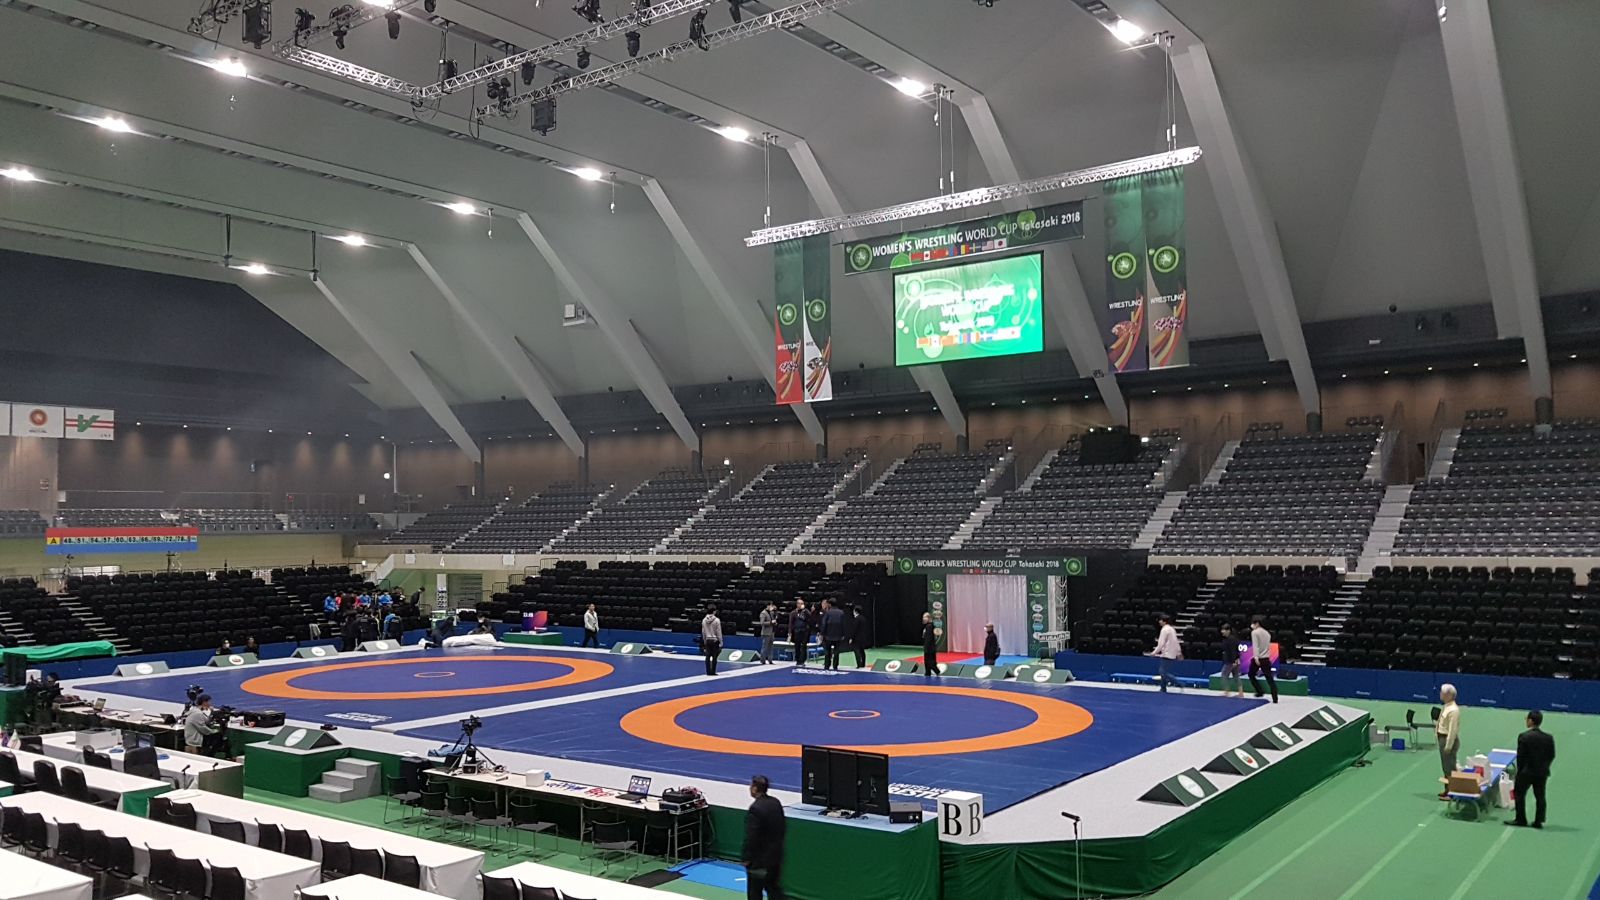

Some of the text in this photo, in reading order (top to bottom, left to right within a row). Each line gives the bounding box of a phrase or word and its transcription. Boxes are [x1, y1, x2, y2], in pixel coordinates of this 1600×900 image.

[872, 211, 1080, 257] WOMEN'S WRESTLING WORLD CUP Takasaki 2018
[1109, 299, 1142, 309] WRESTLING
[1150, 293, 1184, 304] WRESTLING
[917, 559, 1060, 568] WOMEN'S WRESTLING WORLD CUP Takasaki 2018
[942, 802, 962, 836] B
[968, 802, 981, 837] B
